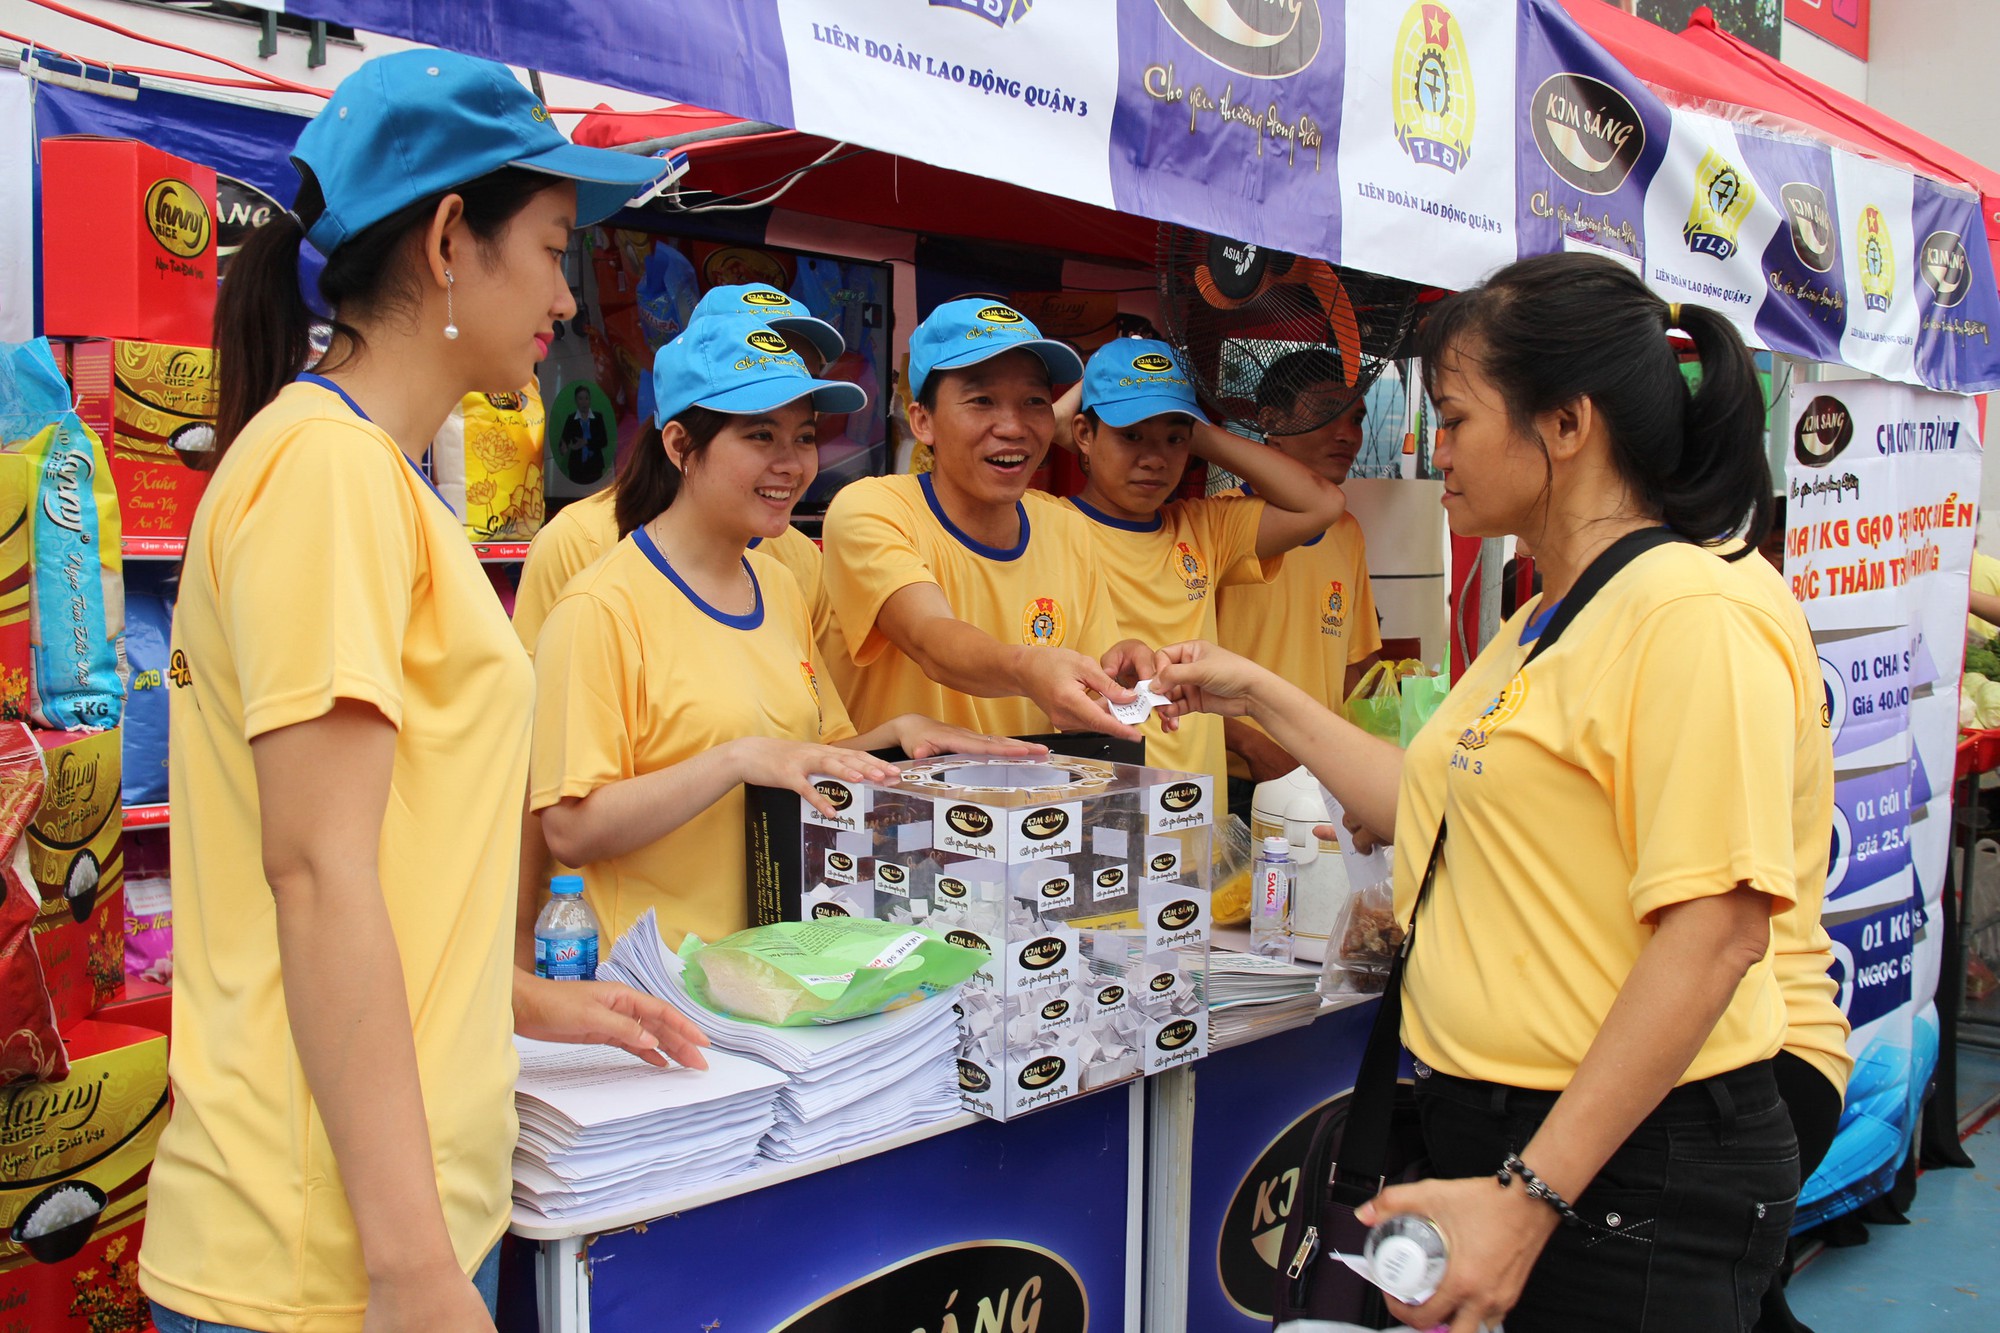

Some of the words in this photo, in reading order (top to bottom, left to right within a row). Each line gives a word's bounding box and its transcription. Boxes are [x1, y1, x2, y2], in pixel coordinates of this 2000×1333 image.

[811, 22, 860, 53] LIÊN
[864, 39, 921, 71] ĐOÀN
[926, 57, 965, 83] LAO
[968, 69, 1021, 98] ĐỘNG
[1024, 85, 1076, 113] QUẬN
[1077, 101, 1089, 117] 3
[1143, 63, 1183, 102] Cho
[1583, 106, 1635, 149] SÁNG
[1413, 141, 1456, 168] TLĐ
[1357, 182, 1385, 201] LIÊN
[1387, 190, 1418, 209] ĐOÀN
[1420, 198, 1439, 216] LAO
[1440, 204, 1467, 223] ĐỘNG
[1468, 214, 1495, 233] QUẬN
[1496, 222, 1502, 234] 3
[156, 226, 178, 239] RICE
[1223, 246, 1241, 263] ASIA
[1695, 236, 1730, 257] TLĐ
[1655, 268, 1670, 282] LIÊN
[1688, 279, 1701, 293] LAO
[1703, 282, 1722, 297] ĐỘNG
[1745, 295, 1751, 304] 3
[131, 469, 177, 492] Xuân
[129, 496, 154, 509] Sum
[1819, 520, 1850, 549] KG
[1856, 515, 1894, 550] GẠO
[1826, 558, 1886, 597] THĂM
[1851, 660, 1869, 683] 01
[1853, 695, 1873, 717] Giá
[1473, 761, 1483, 775] 3
[831, 784, 850, 800] SÁNG
[1180, 786, 1198, 798] SÁNG
[968, 811, 988, 823] SÁNG
[1856, 799, 1876, 822] 01
[1879, 790, 1900, 816] GÓI
[1044, 811, 1064, 825] SÁNG
[1856, 834, 1878, 860] giá
[1266, 872, 1278, 905] SAKA
[1178, 904, 1196, 917] SÁNG
[1041, 940, 1062, 954] SÁNG
[1861, 921, 1883, 951] 01
[1858, 957, 1898, 989] NGỌC
[1176, 1023, 1194, 1036] SÁNG
[1041, 1059, 1061, 1074] SÁNG
[2, 1122, 46, 1144] RICE
